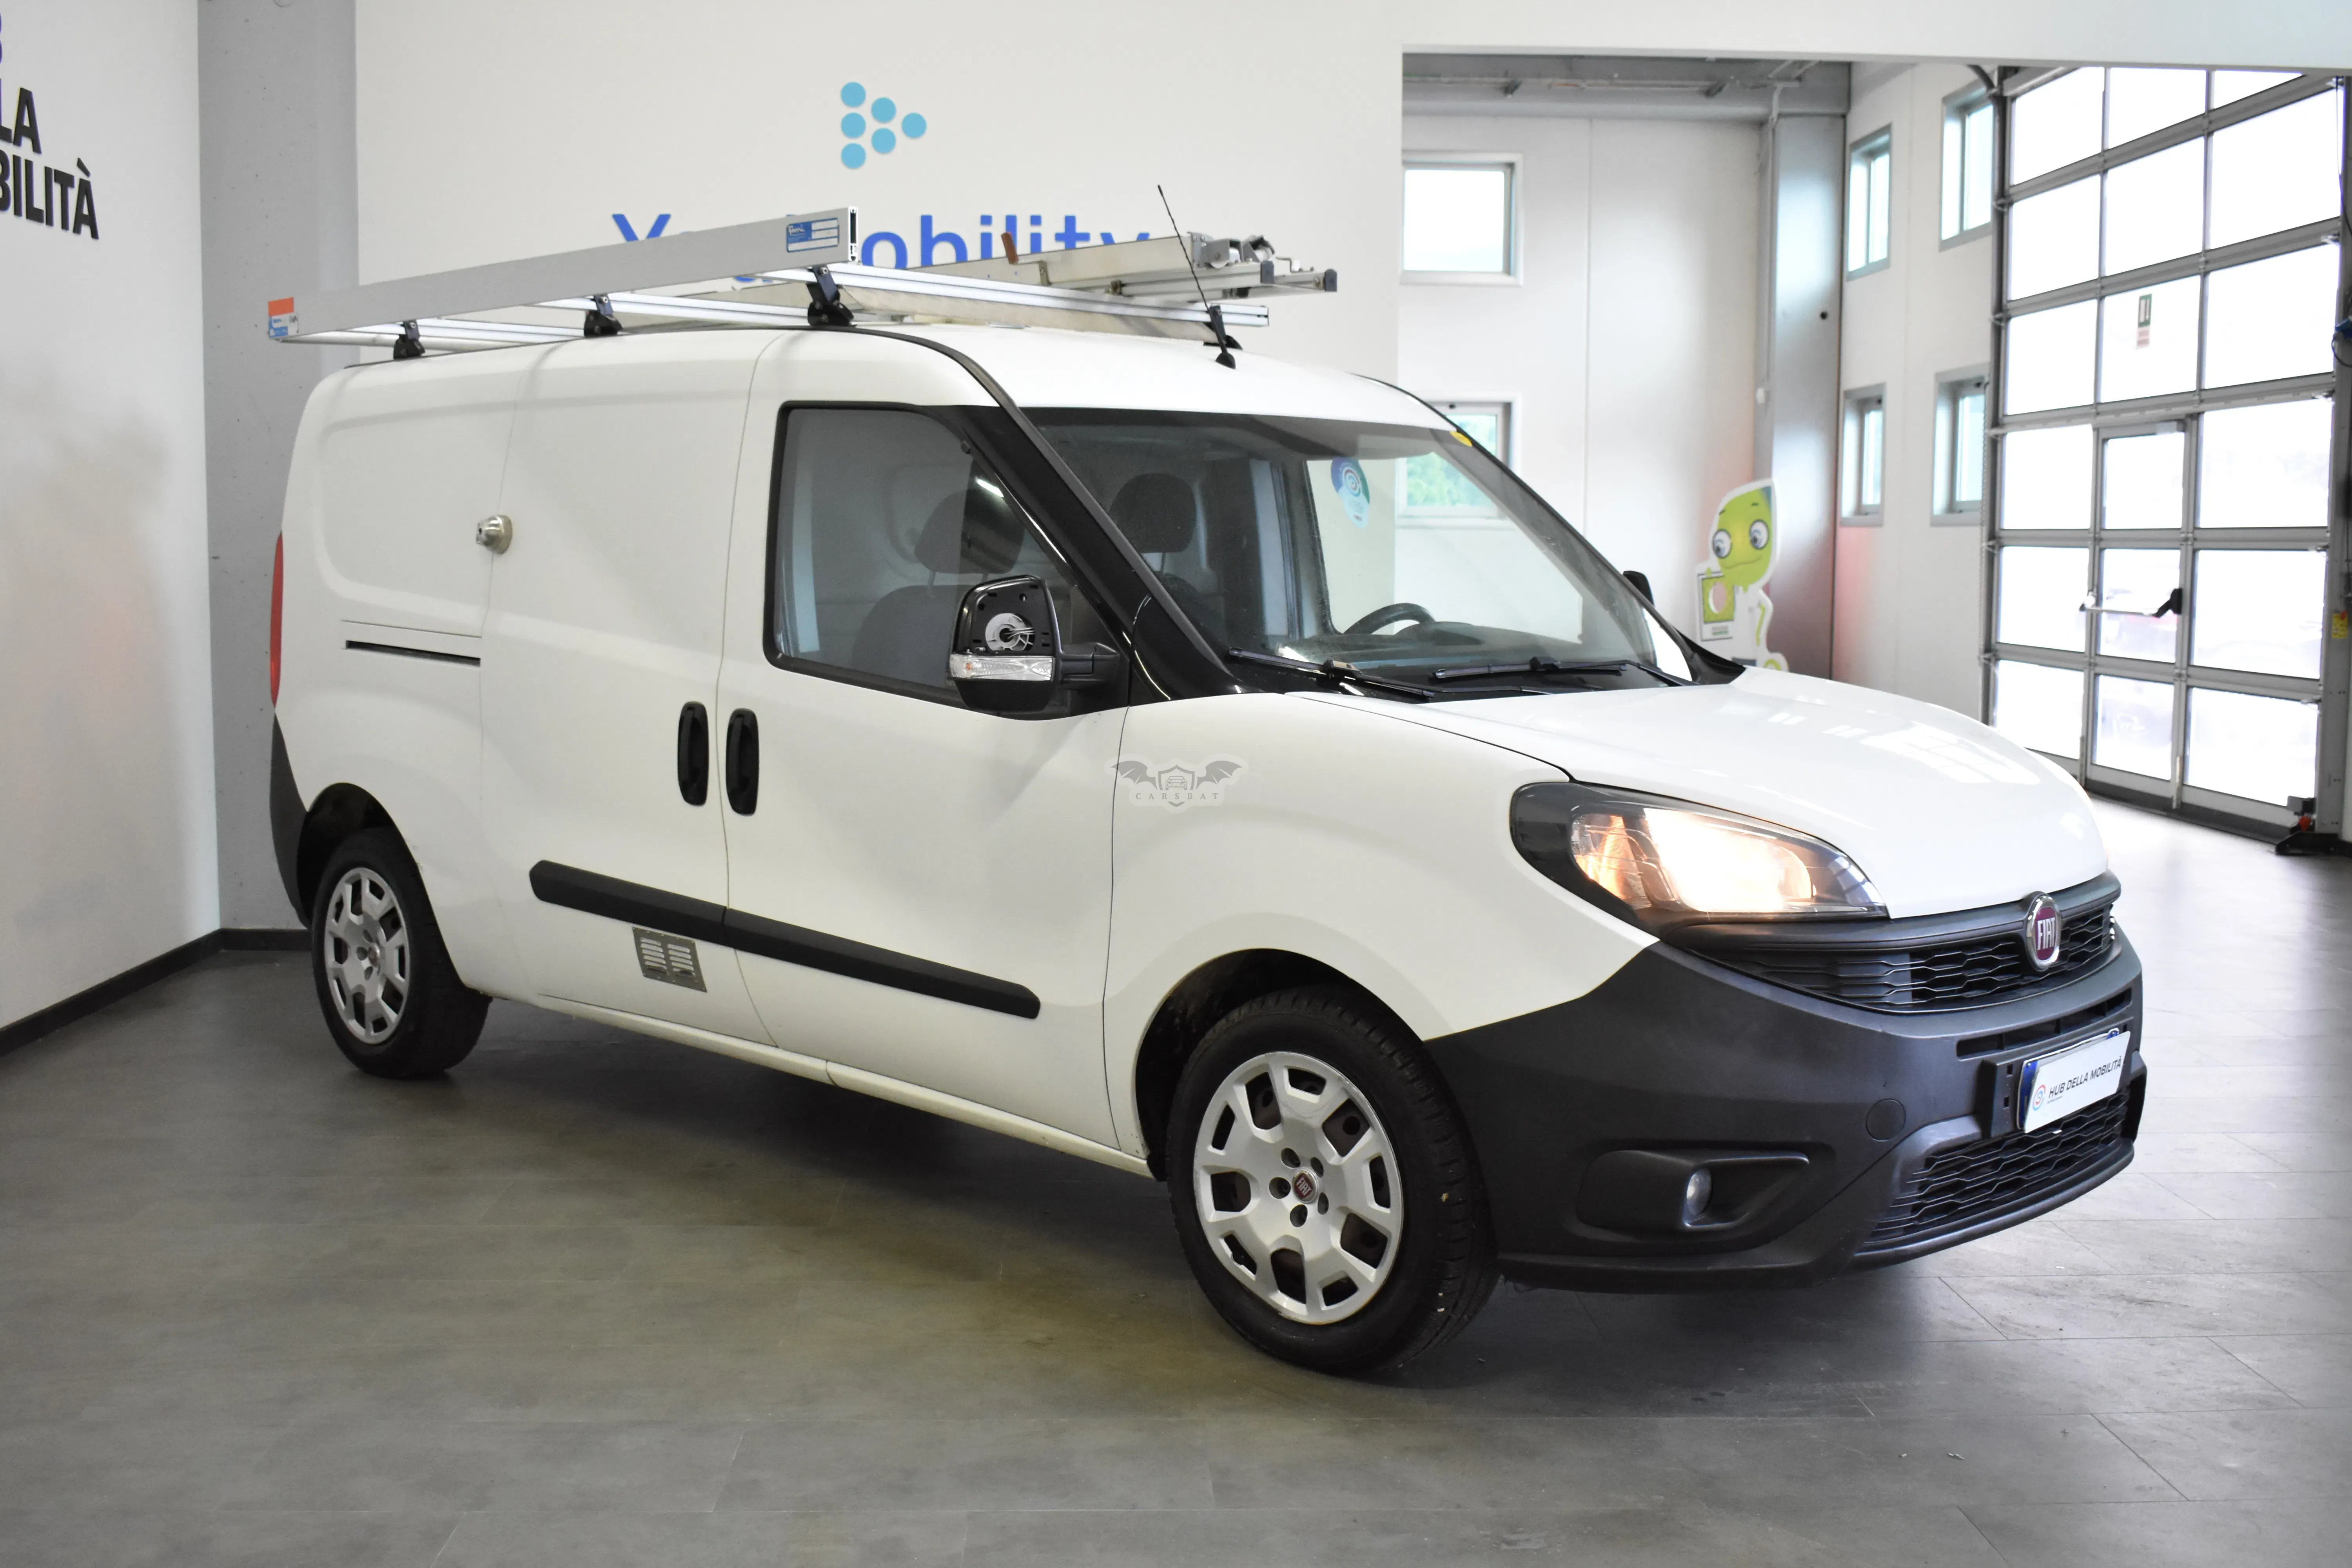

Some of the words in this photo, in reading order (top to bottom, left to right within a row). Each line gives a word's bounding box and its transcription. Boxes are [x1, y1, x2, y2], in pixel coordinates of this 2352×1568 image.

[2037, 917, 2056, 950] FIAT
[2049, 1082, 2065, 1098] HUB
[2066, 1072, 2088, 1090] DELLA
[2089, 1056, 2122, 1080] MOBILITÀ
[1297, 1177, 1312, 1196] FIAT
